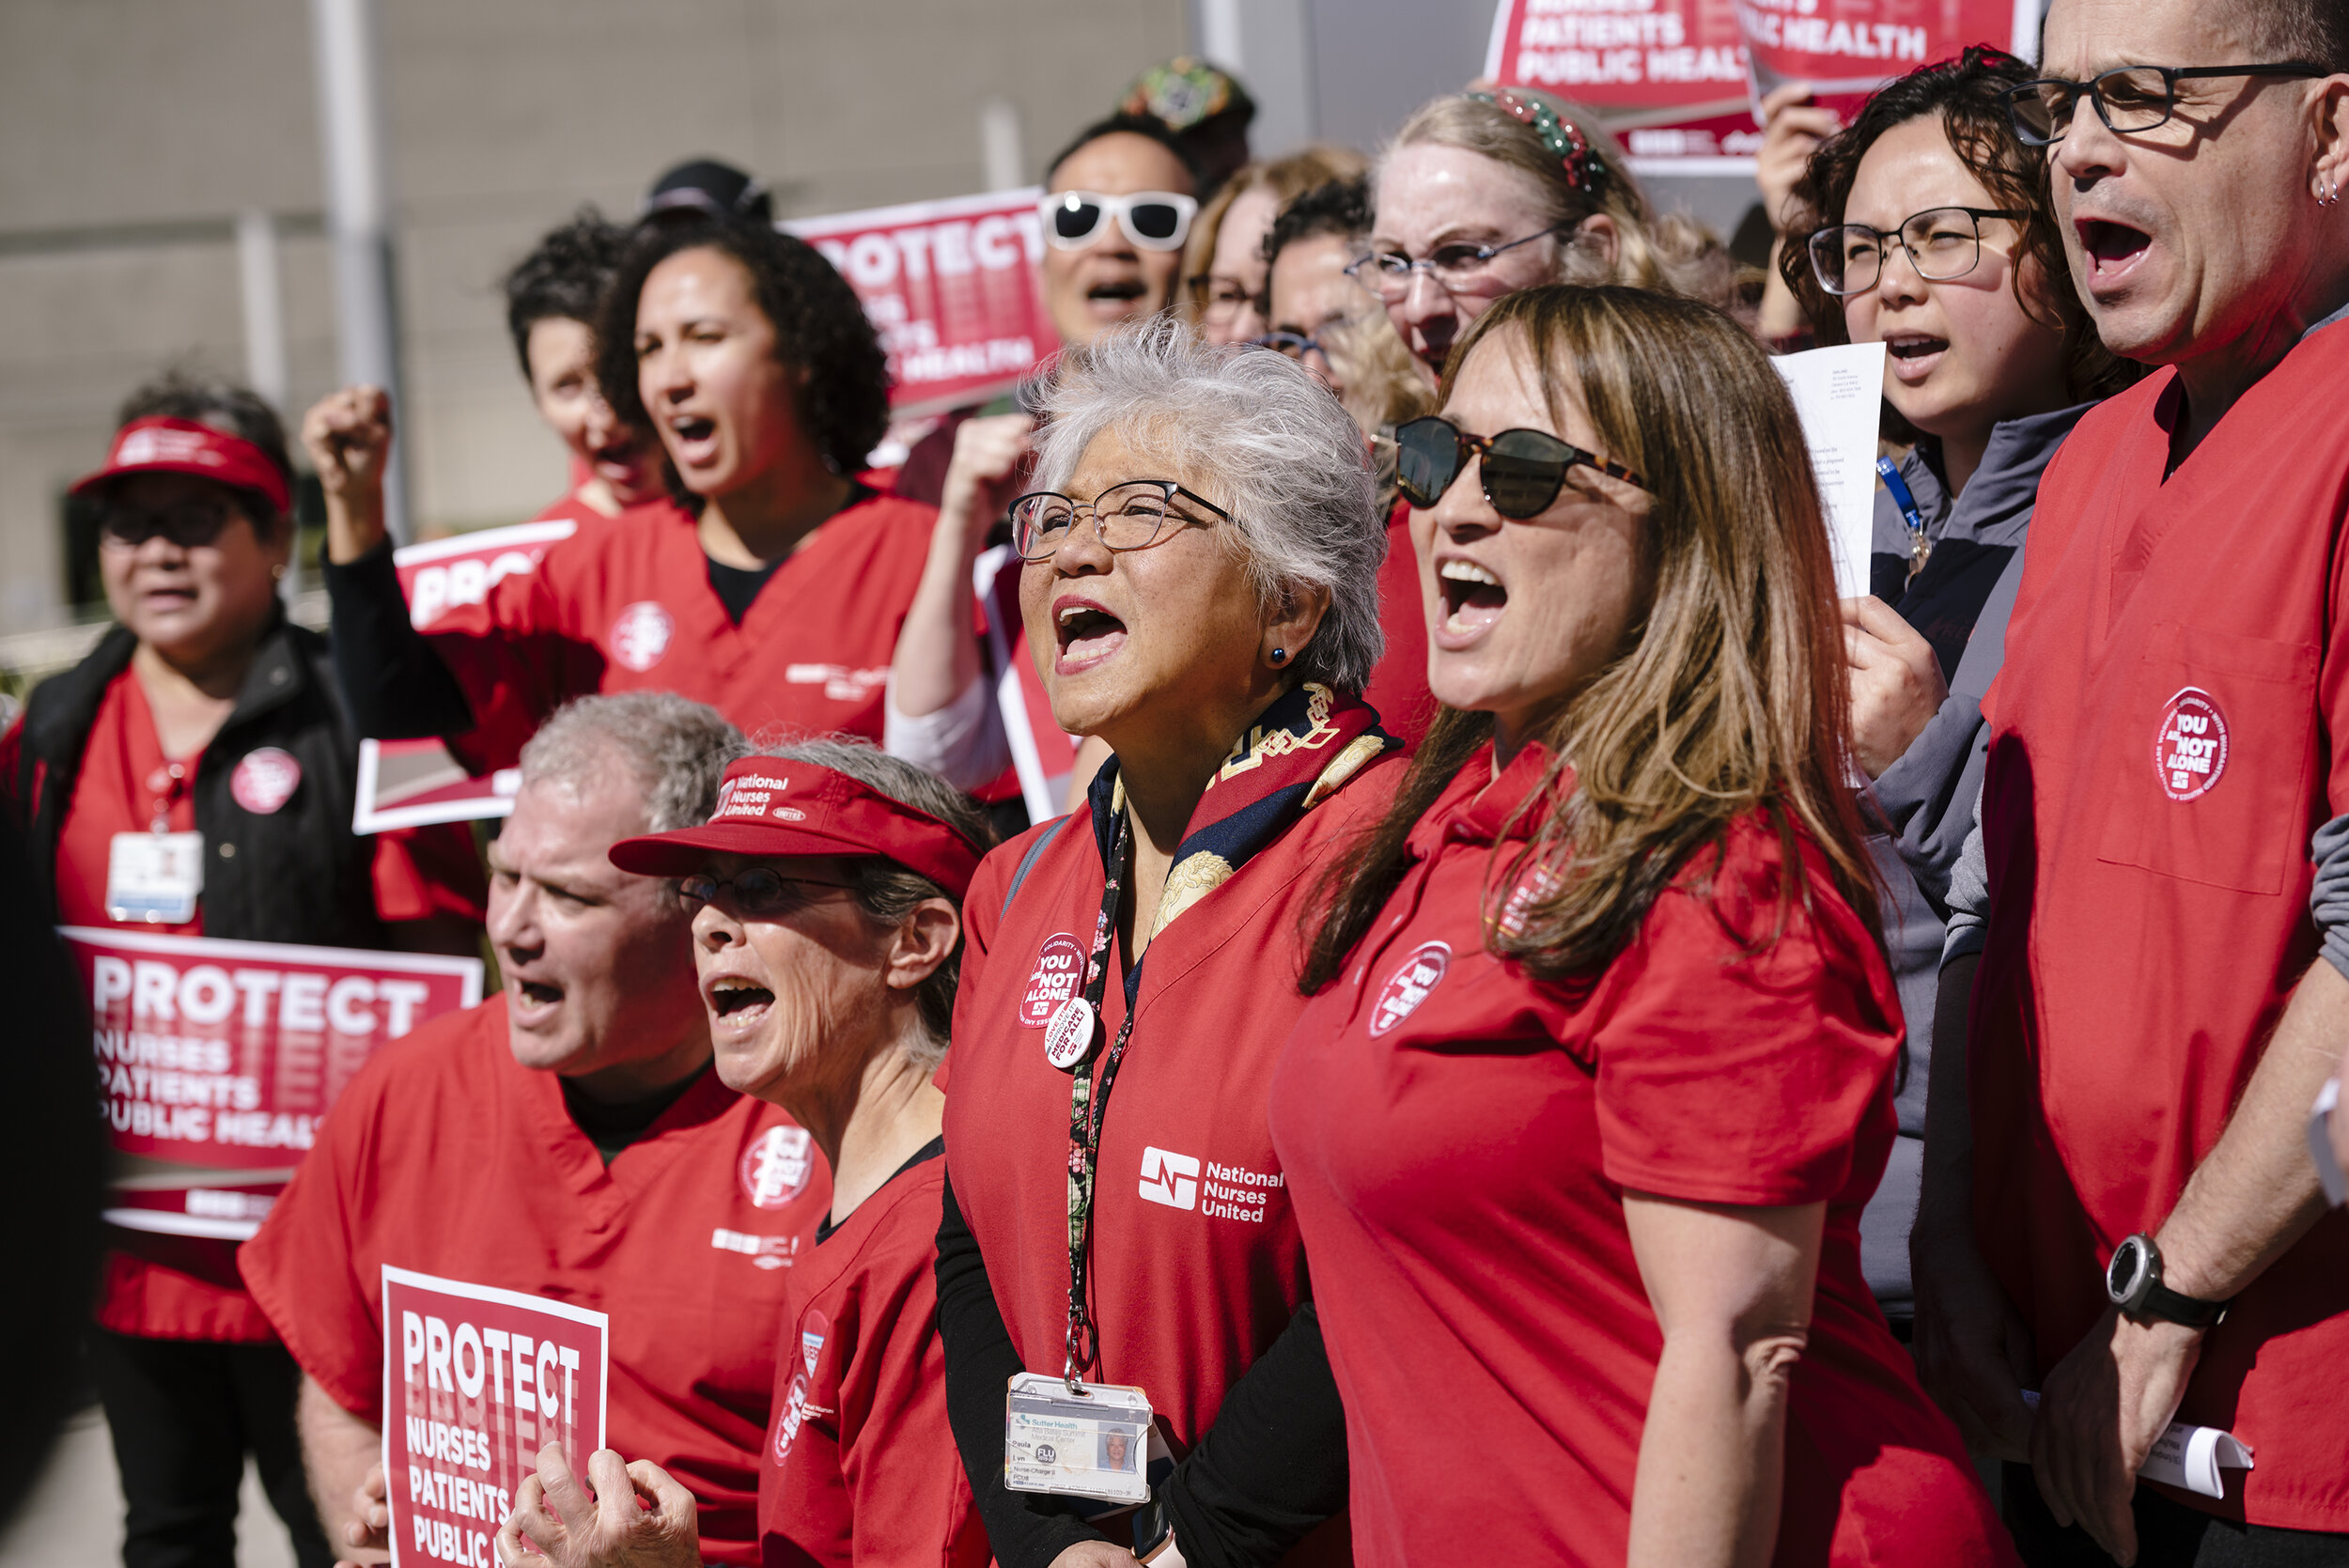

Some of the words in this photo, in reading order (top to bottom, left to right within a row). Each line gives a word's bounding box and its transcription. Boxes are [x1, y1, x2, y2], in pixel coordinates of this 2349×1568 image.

[1783, 17, 1927, 61] HEALTH
[1517, 49, 1642, 85] PUBLIC
[1647, 46, 1748, 83] HEAL
[2177, 714, 2209, 735] YOU
[2176, 736, 2218, 759] NOT
[2166, 753, 2212, 774] ALONE
[737, 773, 789, 790] National
[724, 803, 767, 816] United
[730, 790, 771, 803] Nurses
[1043, 939, 1075, 953] SOLIDARITY
[1040, 955, 1073, 970] YOU
[1038, 972, 1078, 988] NOT
[94, 955, 430, 1039] PROTECT
[1024, 988, 1071, 1004] ALONE
[1046, 1021, 1059, 1042] LOVE
[1057, 1009, 1066, 1021] IT!
[1050, 1012, 1070, 1047] IMPROVE
[1068, 1001, 1077, 1013] IT!
[1051, 1006, 1081, 1057] MEDICARE
[1055, 1036, 1070, 1061] FOR
[1069, 1010, 1085, 1037] ALL!
[94, 1029, 233, 1074] NURSES
[96, 1066, 261, 1111] PATIENTS
[215, 1110, 323, 1149] HEAL
[1206, 1161, 1284, 1188] National
[1204, 1180, 1267, 1205] Nurses
[1202, 1199, 1264, 1222] United
[402, 1310, 580, 1425] PROTECT
[1054, 1421, 1078, 1429] Health
[405, 1414, 491, 1471] NURSES
[1037, 1448, 1054, 1457] FLU
[409, 1465, 509, 1527] PATIENTS
[412, 1514, 490, 1568] PUBLIC
